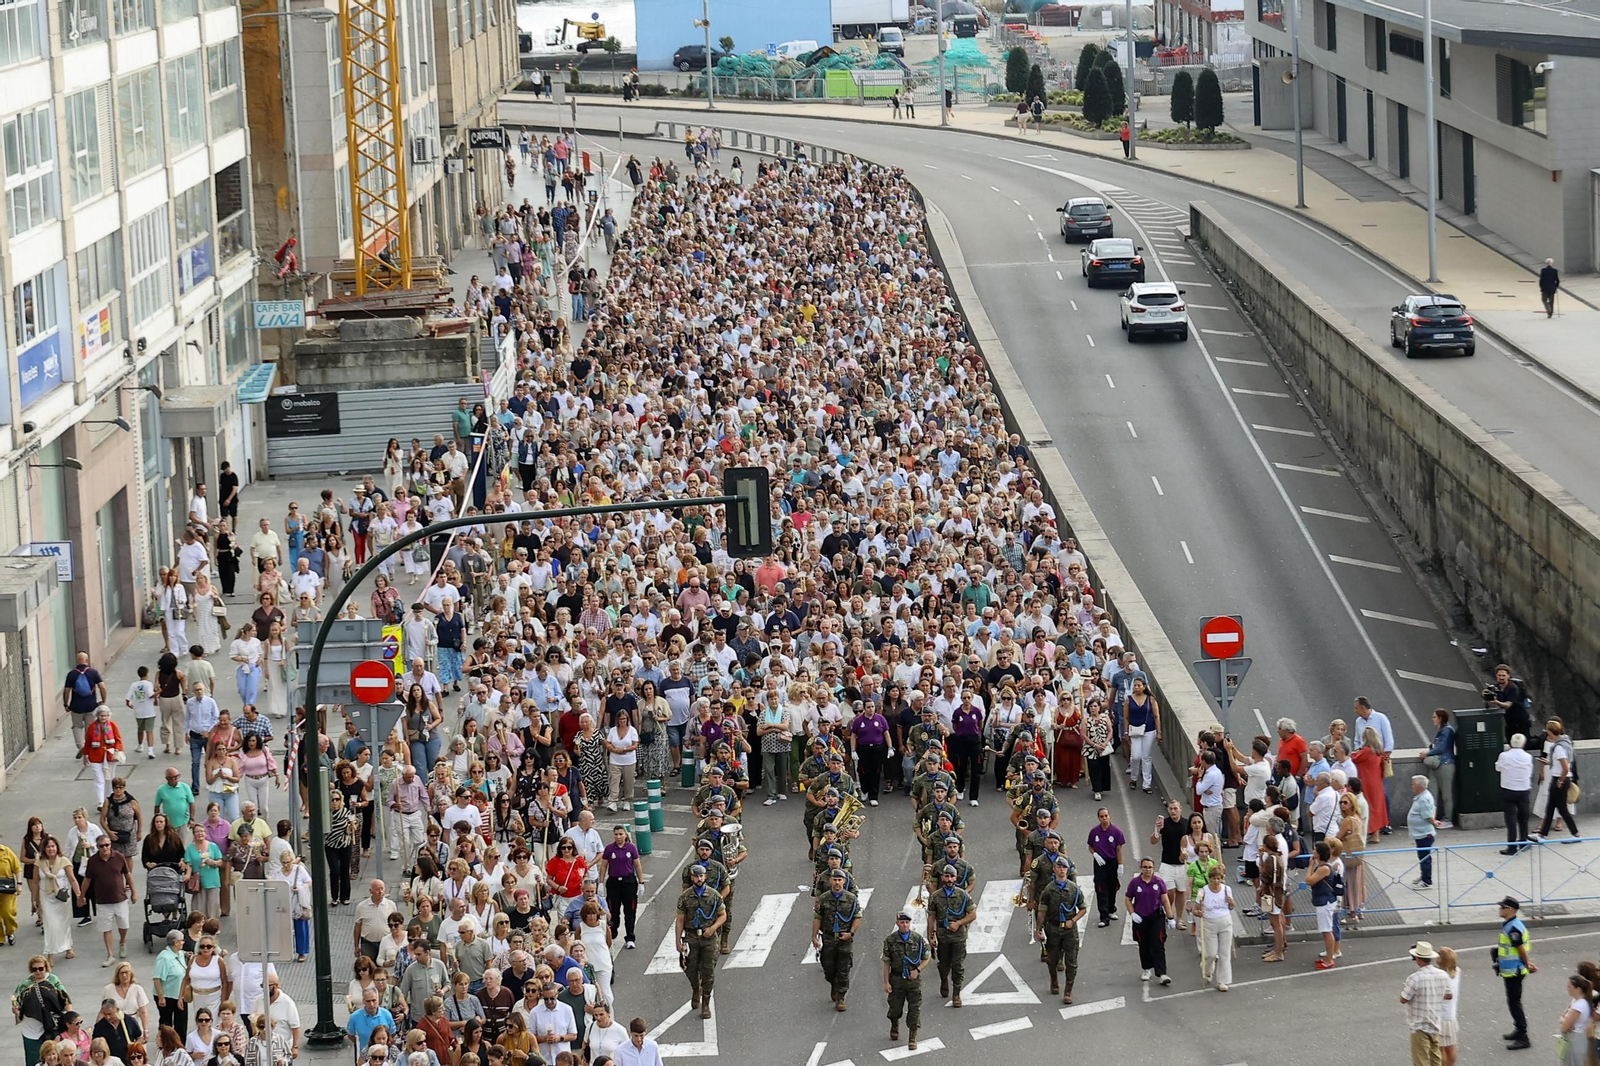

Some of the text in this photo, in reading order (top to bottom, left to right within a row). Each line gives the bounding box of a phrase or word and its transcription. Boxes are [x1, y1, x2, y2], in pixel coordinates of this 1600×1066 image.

[256, 303, 300, 313] CAFÉ BAR
[257, 312, 300, 327] LIÑA
